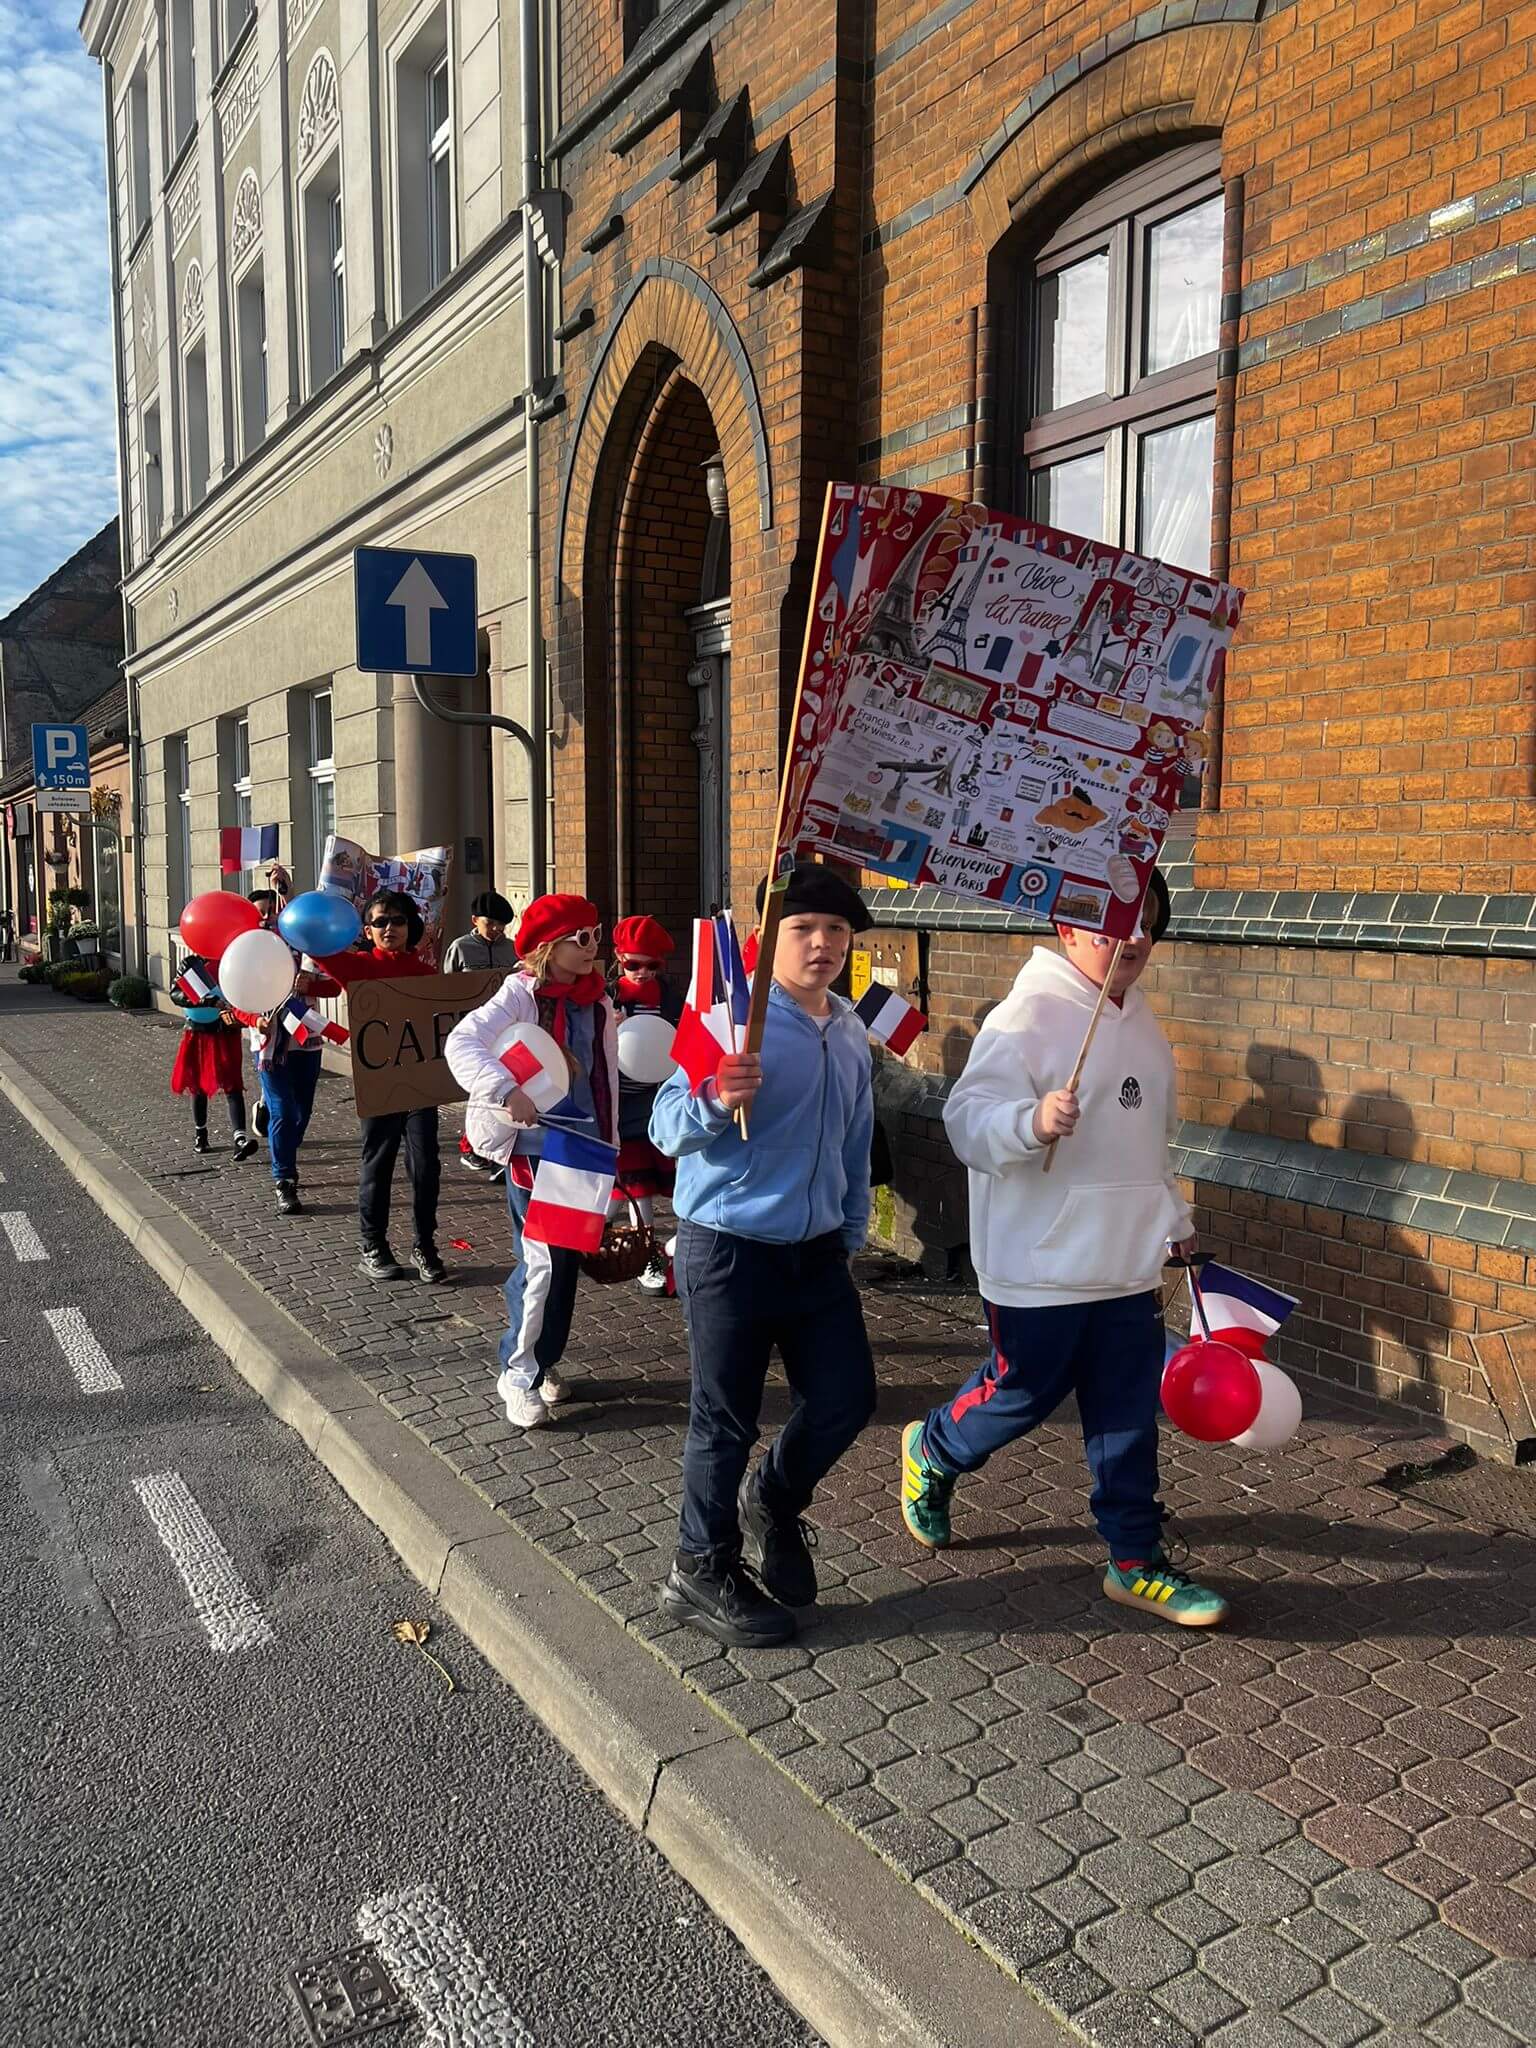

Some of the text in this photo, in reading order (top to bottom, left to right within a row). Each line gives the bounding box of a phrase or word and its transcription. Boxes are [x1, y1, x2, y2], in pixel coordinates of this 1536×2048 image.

[1014, 562, 1075, 599] Vive
[1007, 598, 1077, 640] France
[856, 708, 891, 729] Francja
[45, 729, 77, 769] P
[930, 847, 1001, 876] Bienvenue
